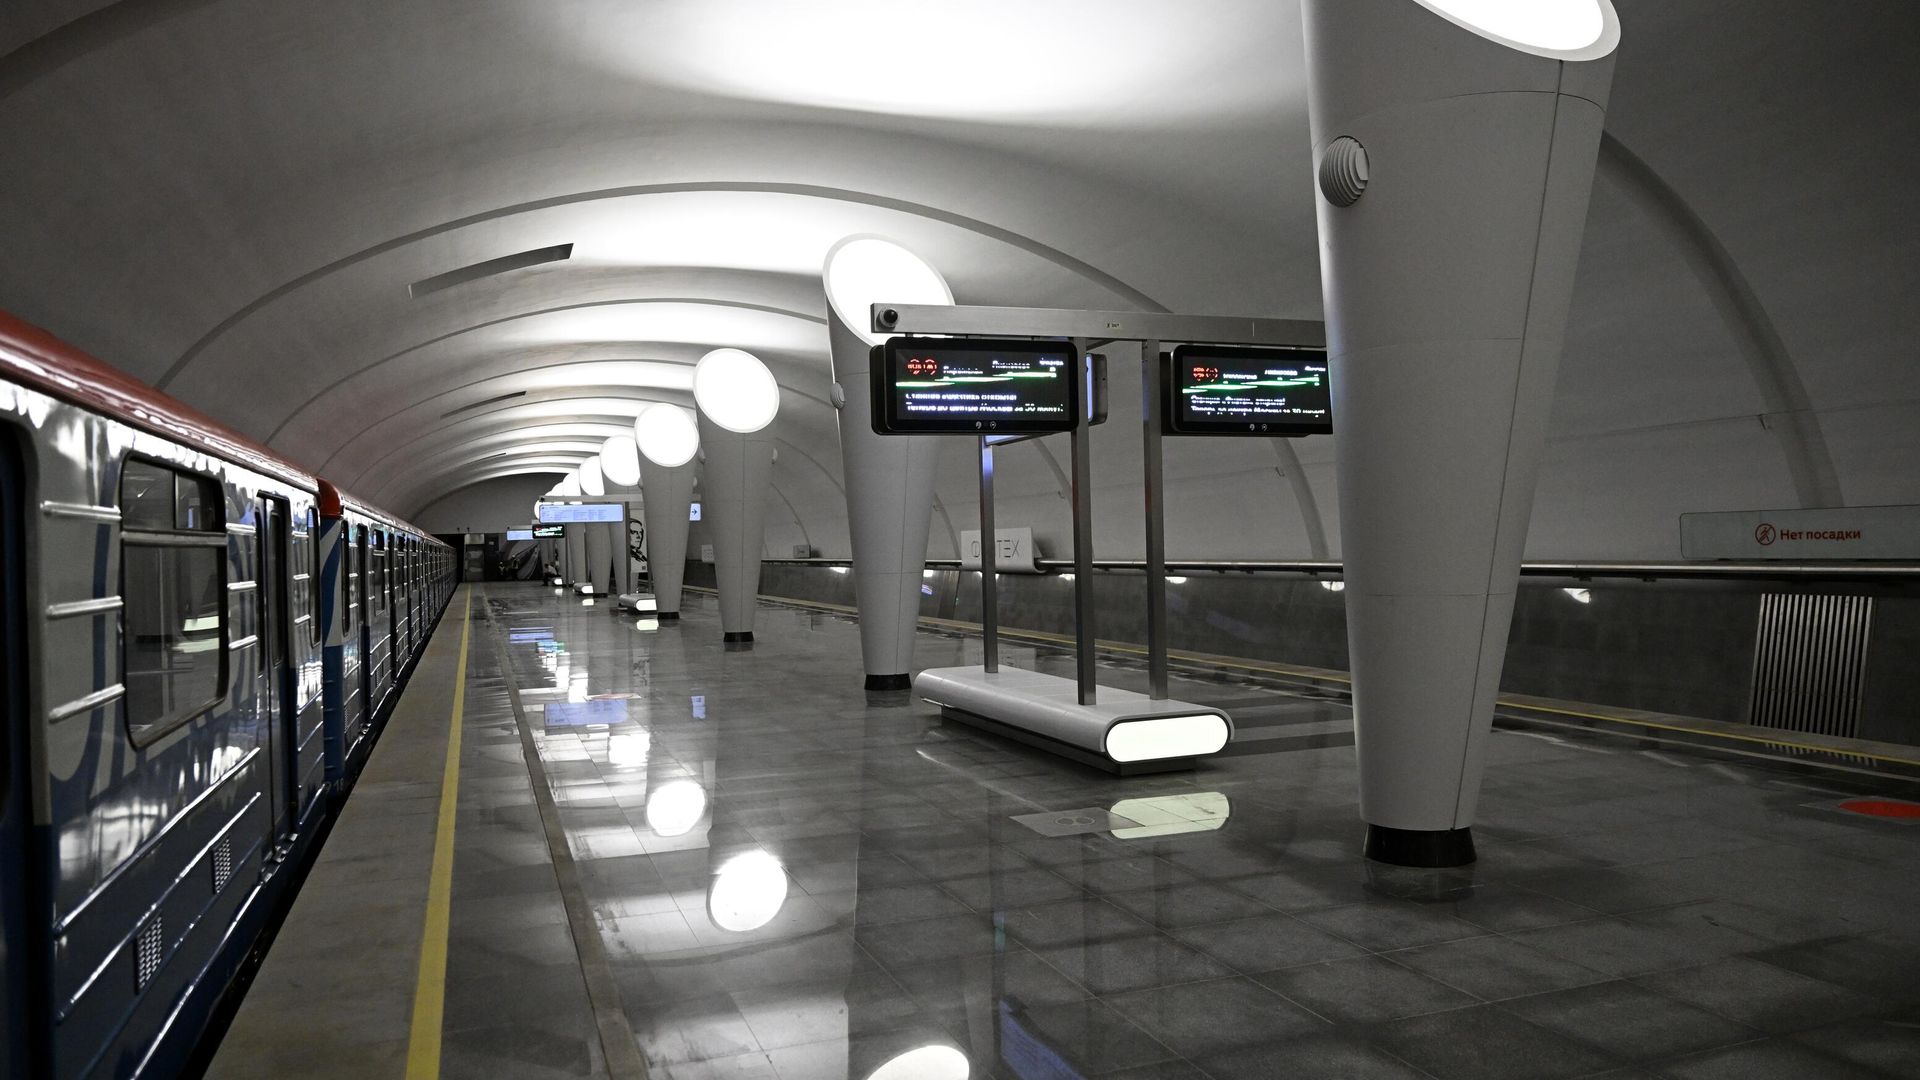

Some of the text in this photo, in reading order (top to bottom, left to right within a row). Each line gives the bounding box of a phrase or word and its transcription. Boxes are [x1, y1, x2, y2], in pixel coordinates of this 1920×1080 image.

[1780, 529, 1861, 541] Нет посадки
[971, 539, 1020, 558] ФТЕХ
